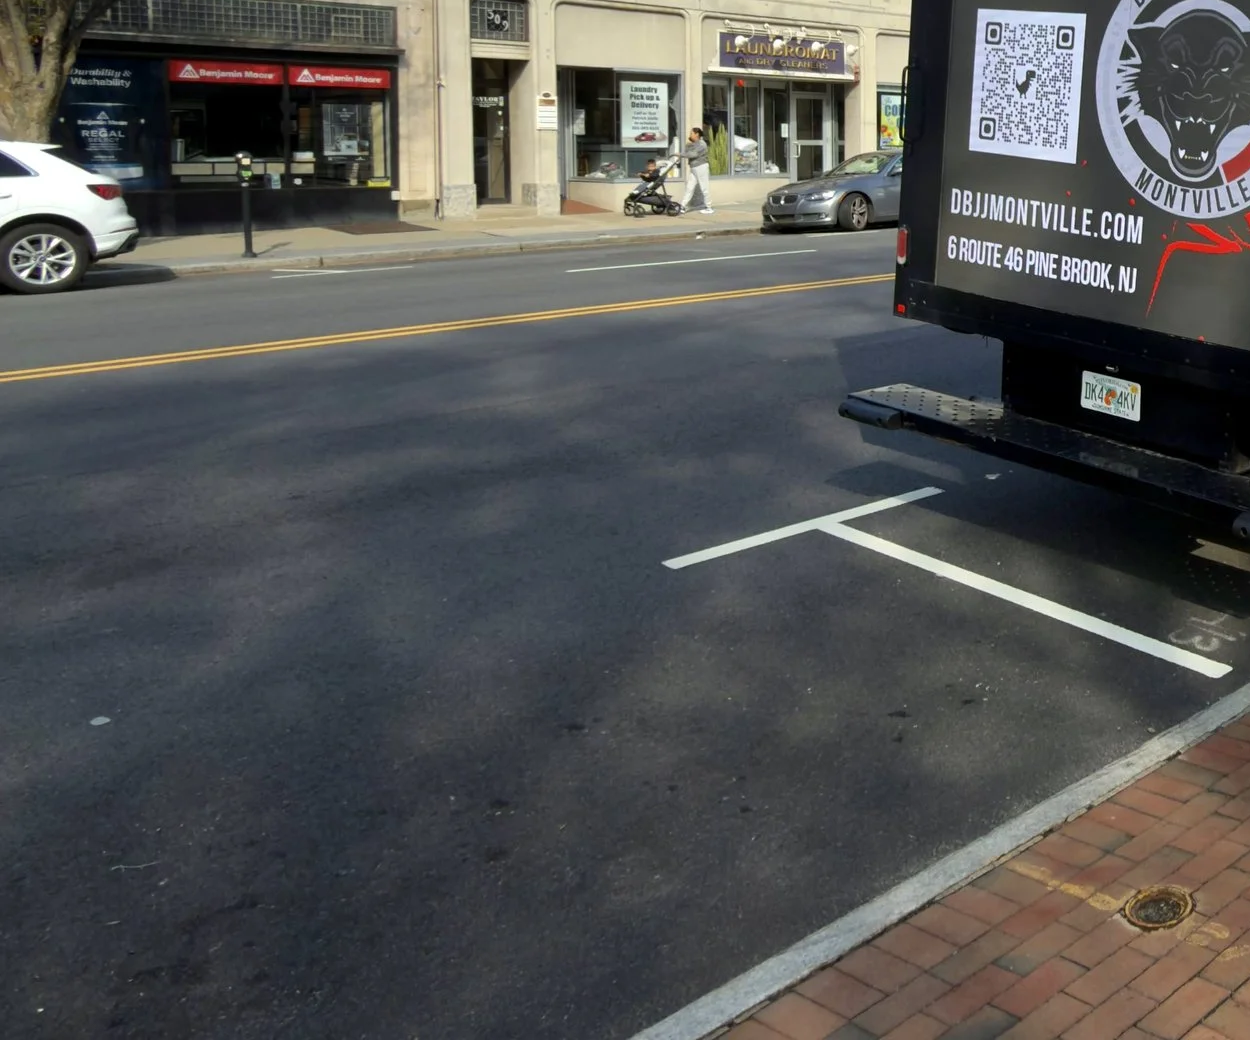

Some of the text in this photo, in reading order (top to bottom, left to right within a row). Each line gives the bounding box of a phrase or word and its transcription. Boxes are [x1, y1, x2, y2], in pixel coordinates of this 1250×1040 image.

[756, 58, 775, 67] DRY
[780, 59, 828, 70] CLEANERS
[71, 68, 121, 78] Durability
[199, 69, 274, 80] Benjamin Moore
[315, 73, 382, 84] Benjamin Moore
[71, 77, 132, 89] Washability
[630, 85, 658, 94] Laundry
[629, 93, 645, 101] Pick
[631, 101, 659, 109] Delivery
[884, 104, 902, 117] CO
[81, 129, 126, 138] REGAL
[951, 187, 1144, 245] DBJJMONTVILLE.COM
[947, 235, 1138, 294] 6 ROUTE 46 PINE BROOK, NJ
[1084, 381, 1137, 412] DK4 4KV
